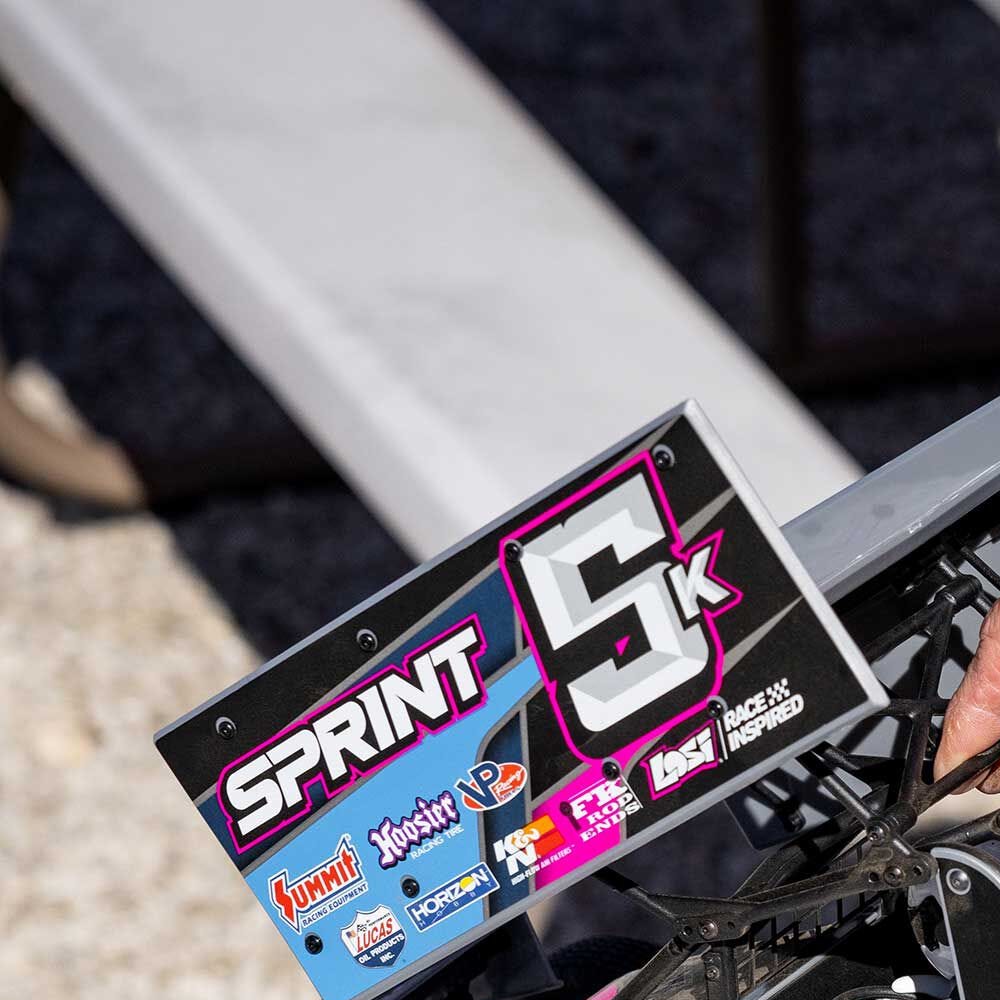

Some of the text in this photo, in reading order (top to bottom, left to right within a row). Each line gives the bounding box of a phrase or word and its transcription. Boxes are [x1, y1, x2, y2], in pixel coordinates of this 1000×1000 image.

[226, 625, 480, 836] SPRINT
[724, 692, 766, 731] RACE
[727, 693, 804, 752] INSPIRED
[455, 762, 499, 808] VP
[369, 792, 458, 867] Hoosier
[579, 802, 641, 843] ENDS
[587, 793, 633, 825] ROD
[411, 824, 465, 860] RACING TIRE
[302, 883, 368, 926] RACING EQUIPMENT
[411, 867, 490, 922] HORIZON
[357, 917, 393, 953] LUCAS
[358, 933, 405, 964] OIL PRODUCTS
